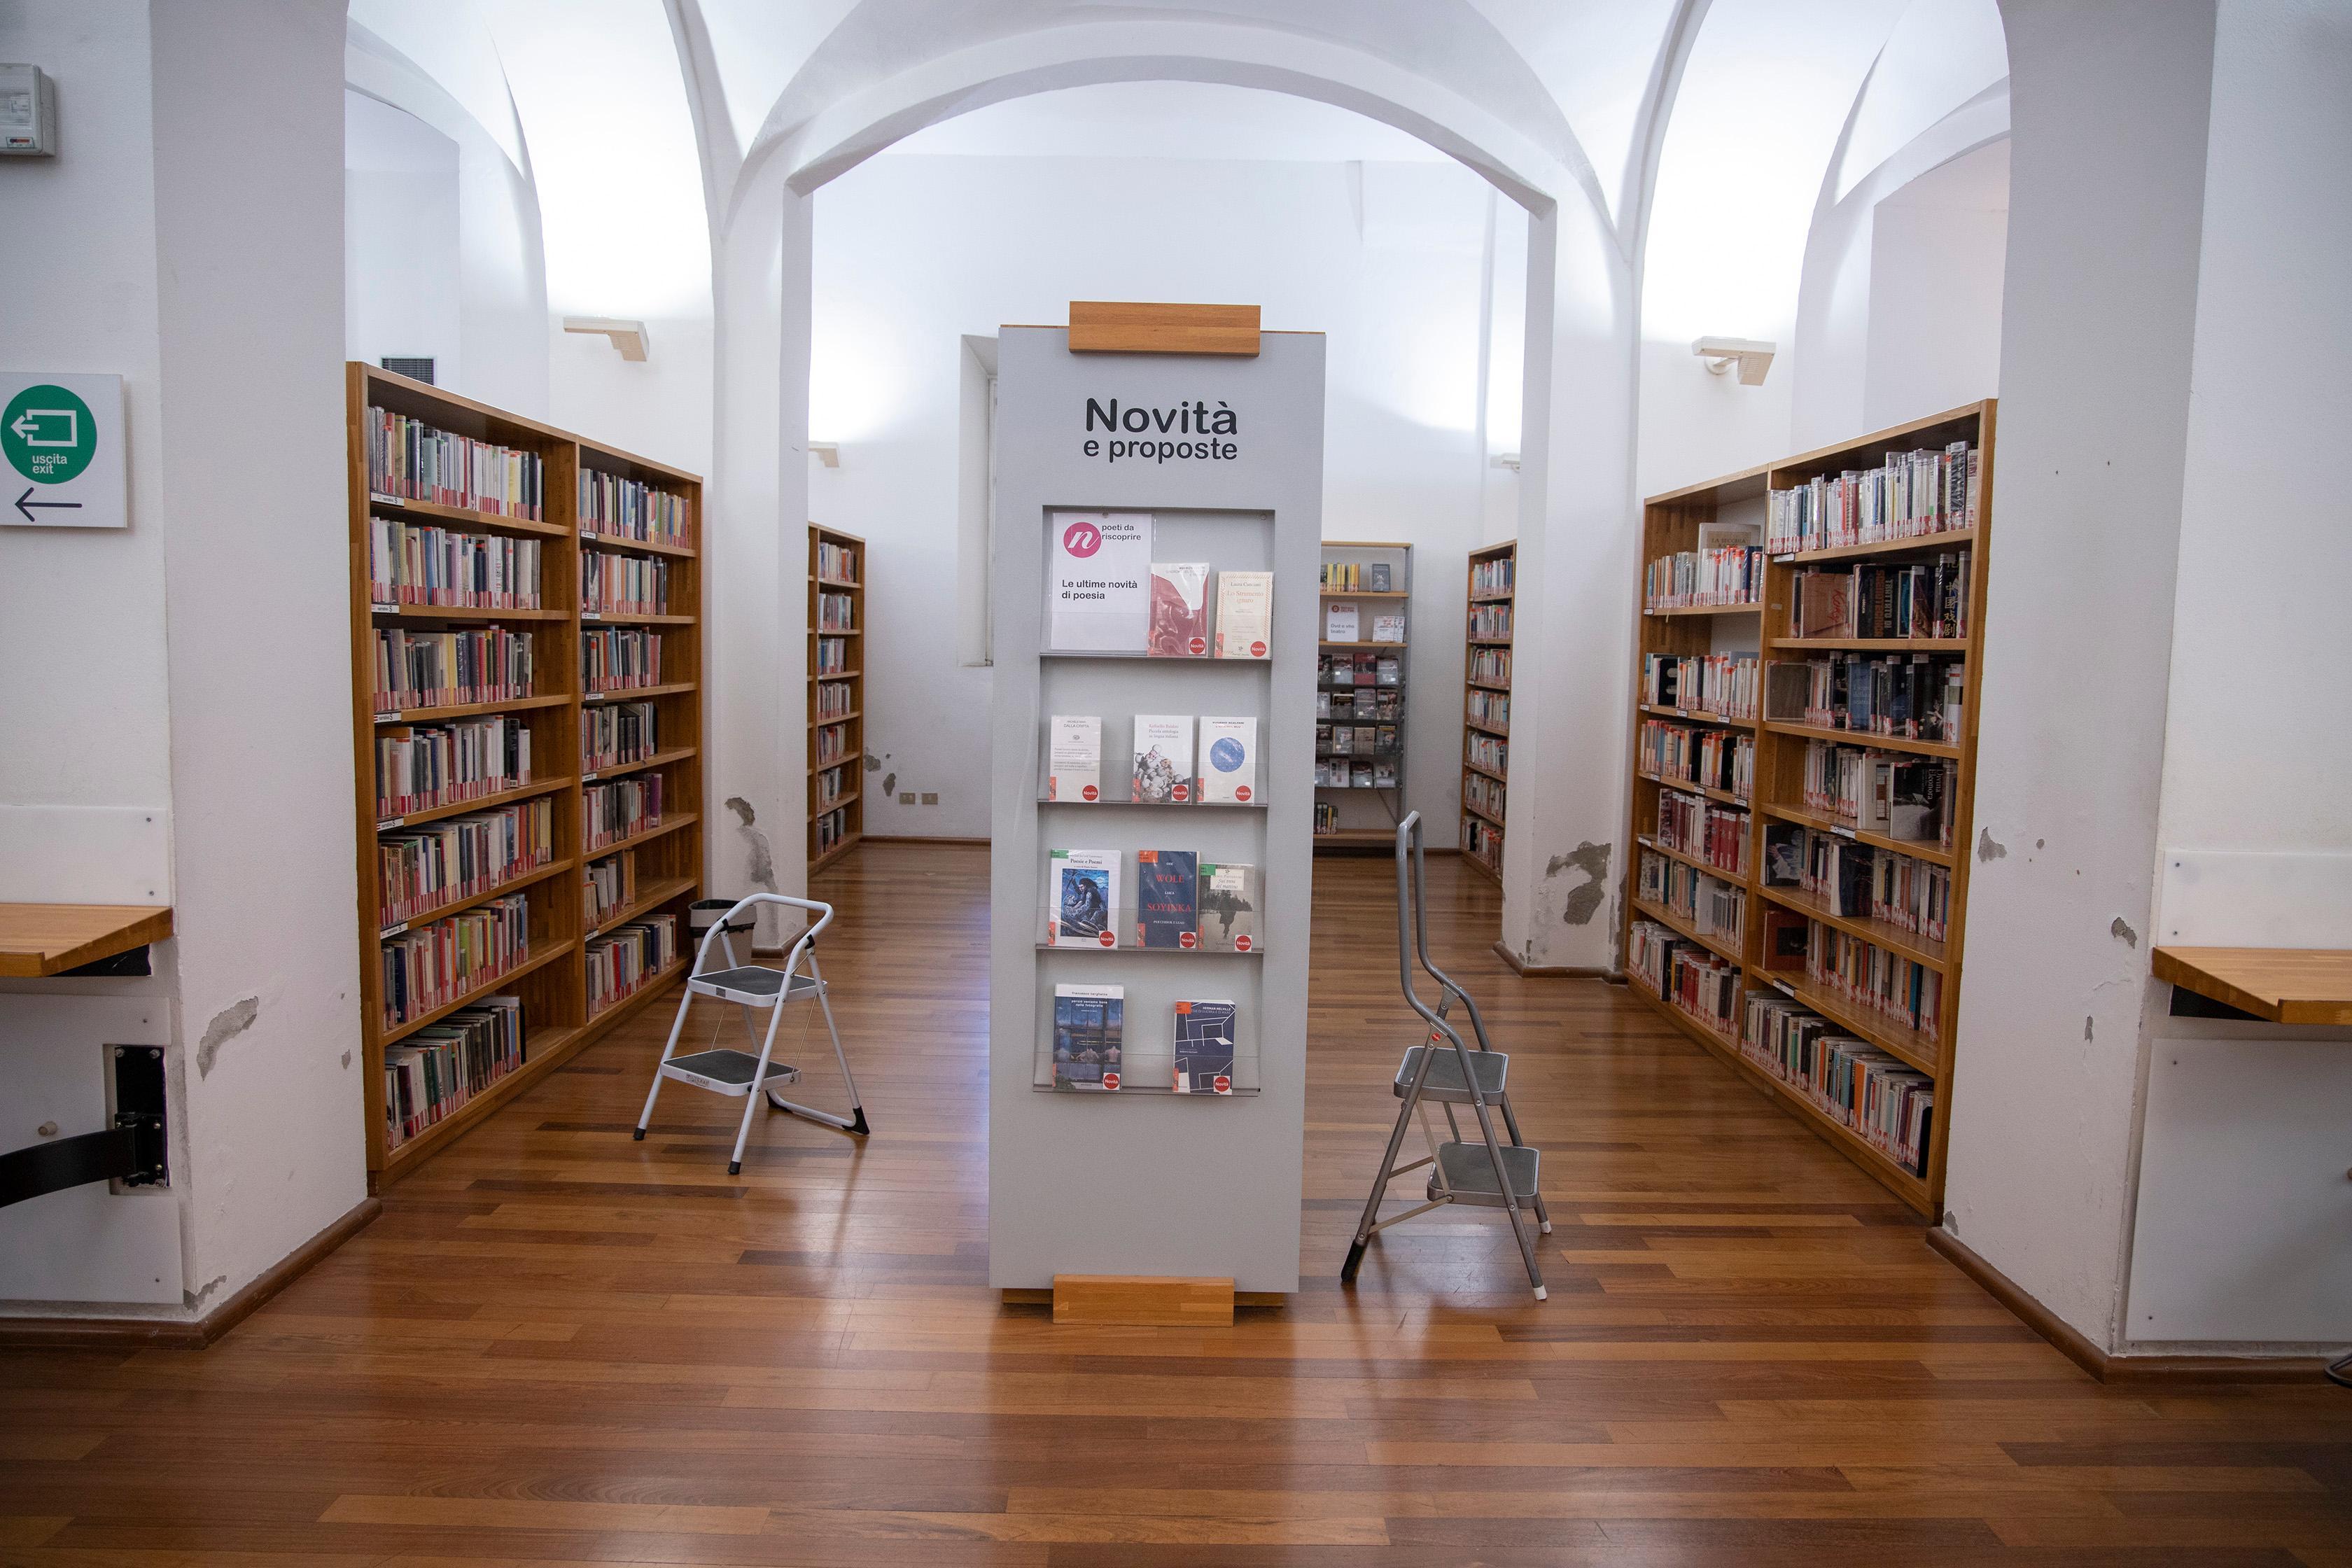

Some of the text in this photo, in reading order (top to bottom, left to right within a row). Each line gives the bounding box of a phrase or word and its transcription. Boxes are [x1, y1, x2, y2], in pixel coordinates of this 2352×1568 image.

[1085, 397, 1238, 435] Novità
[1083, 437, 1238, 464] e proposte
[32, 454, 68, 465] uscita
[32, 463, 54, 474] exit
[1102, 533, 1142, 541] riscoprire
[1061, 579, 1138, 589] Le ultime novità
[1061, 591, 1105, 601] di poesia
[1927, 769, 1936, 800] Eleonora
[1156, 874, 1184, 883] WOLE
[1147, 903, 1191, 913] SOYINKA
